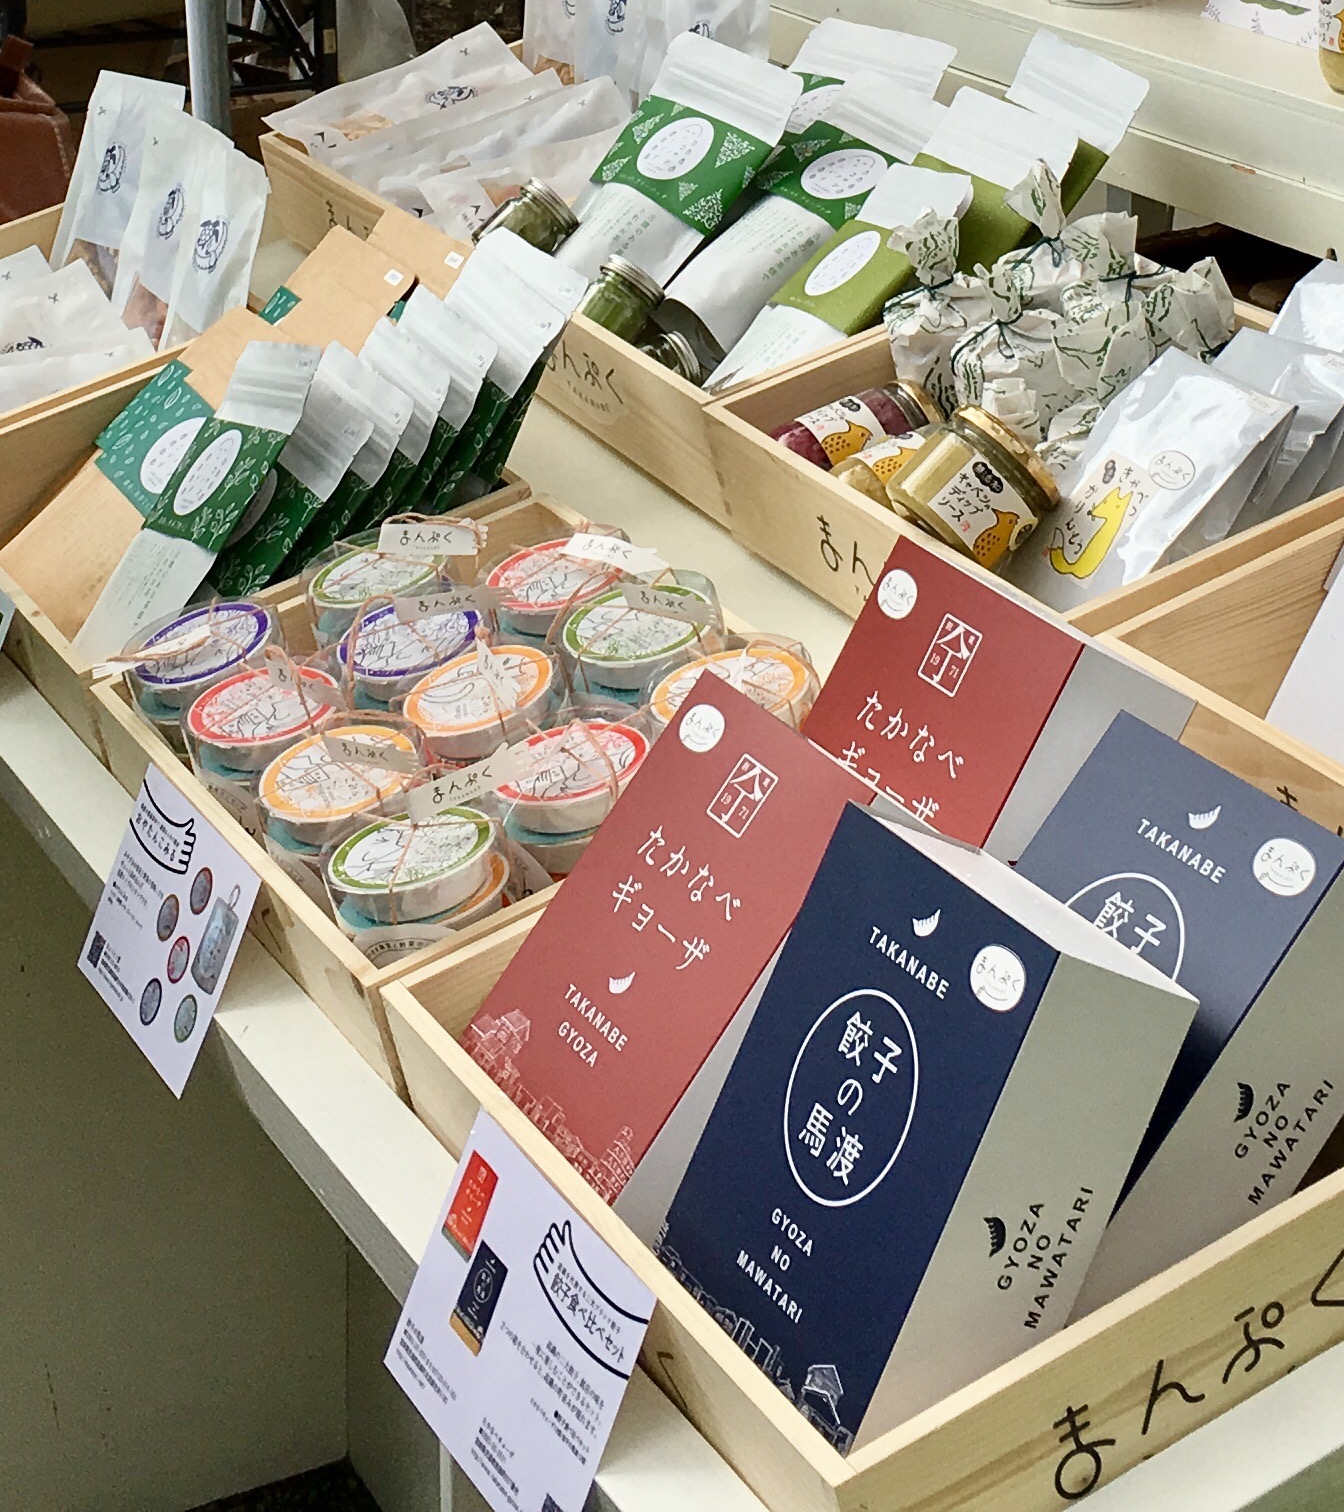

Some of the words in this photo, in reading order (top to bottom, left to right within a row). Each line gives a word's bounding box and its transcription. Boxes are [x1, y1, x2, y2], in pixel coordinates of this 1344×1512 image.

[937, 495, 965, 523] ソース
[948, 485, 984, 516] ディップ
[398, 529, 455, 547] まんぷく
[417, 592, 477, 614] まんぷく
[341, 741, 389, 764] まんぷく
[855, 689, 965, 780] たかなべ
[430, 764, 494, 806] まんぷく
[636, 824, 743, 922] たかなべ
[1135, 817, 1227, 885] TAKANABE
[1260, 844, 1311, 884] まんぷく
[611, 874, 712, 971] ギョーザ
[1091, 889, 1168, 957] 餃子
[870, 925, 951, 1001] TAKANABE
[975, 953, 1025, 996] まんぷく
[557, 1020, 600, 1069] GYOZA
[563, 983, 630, 1053] TAKANABE
[837, 1010, 904, 1085] 餃子
[836, 1077, 864, 1116] の
[1233, 1080, 1292, 1159] GYOZA
[1261, 1112, 1290, 1149] NO
[797, 1102, 865, 1187] 馬渡
[1247, 1078, 1336, 1206] MAWATARI
[770, 1207, 816, 1258] GYOZA
[770, 1244, 792, 1273] NO
[995, 1200, 1045, 1291] GYOZA
[1022, 1185, 1095, 1331] MAWATARI
[1027, 1233, 1052, 1271] NO
[550, 1272, 626, 1364] 餃子食べ比べセット
[734, 1248, 805, 1325] MAWATARI
